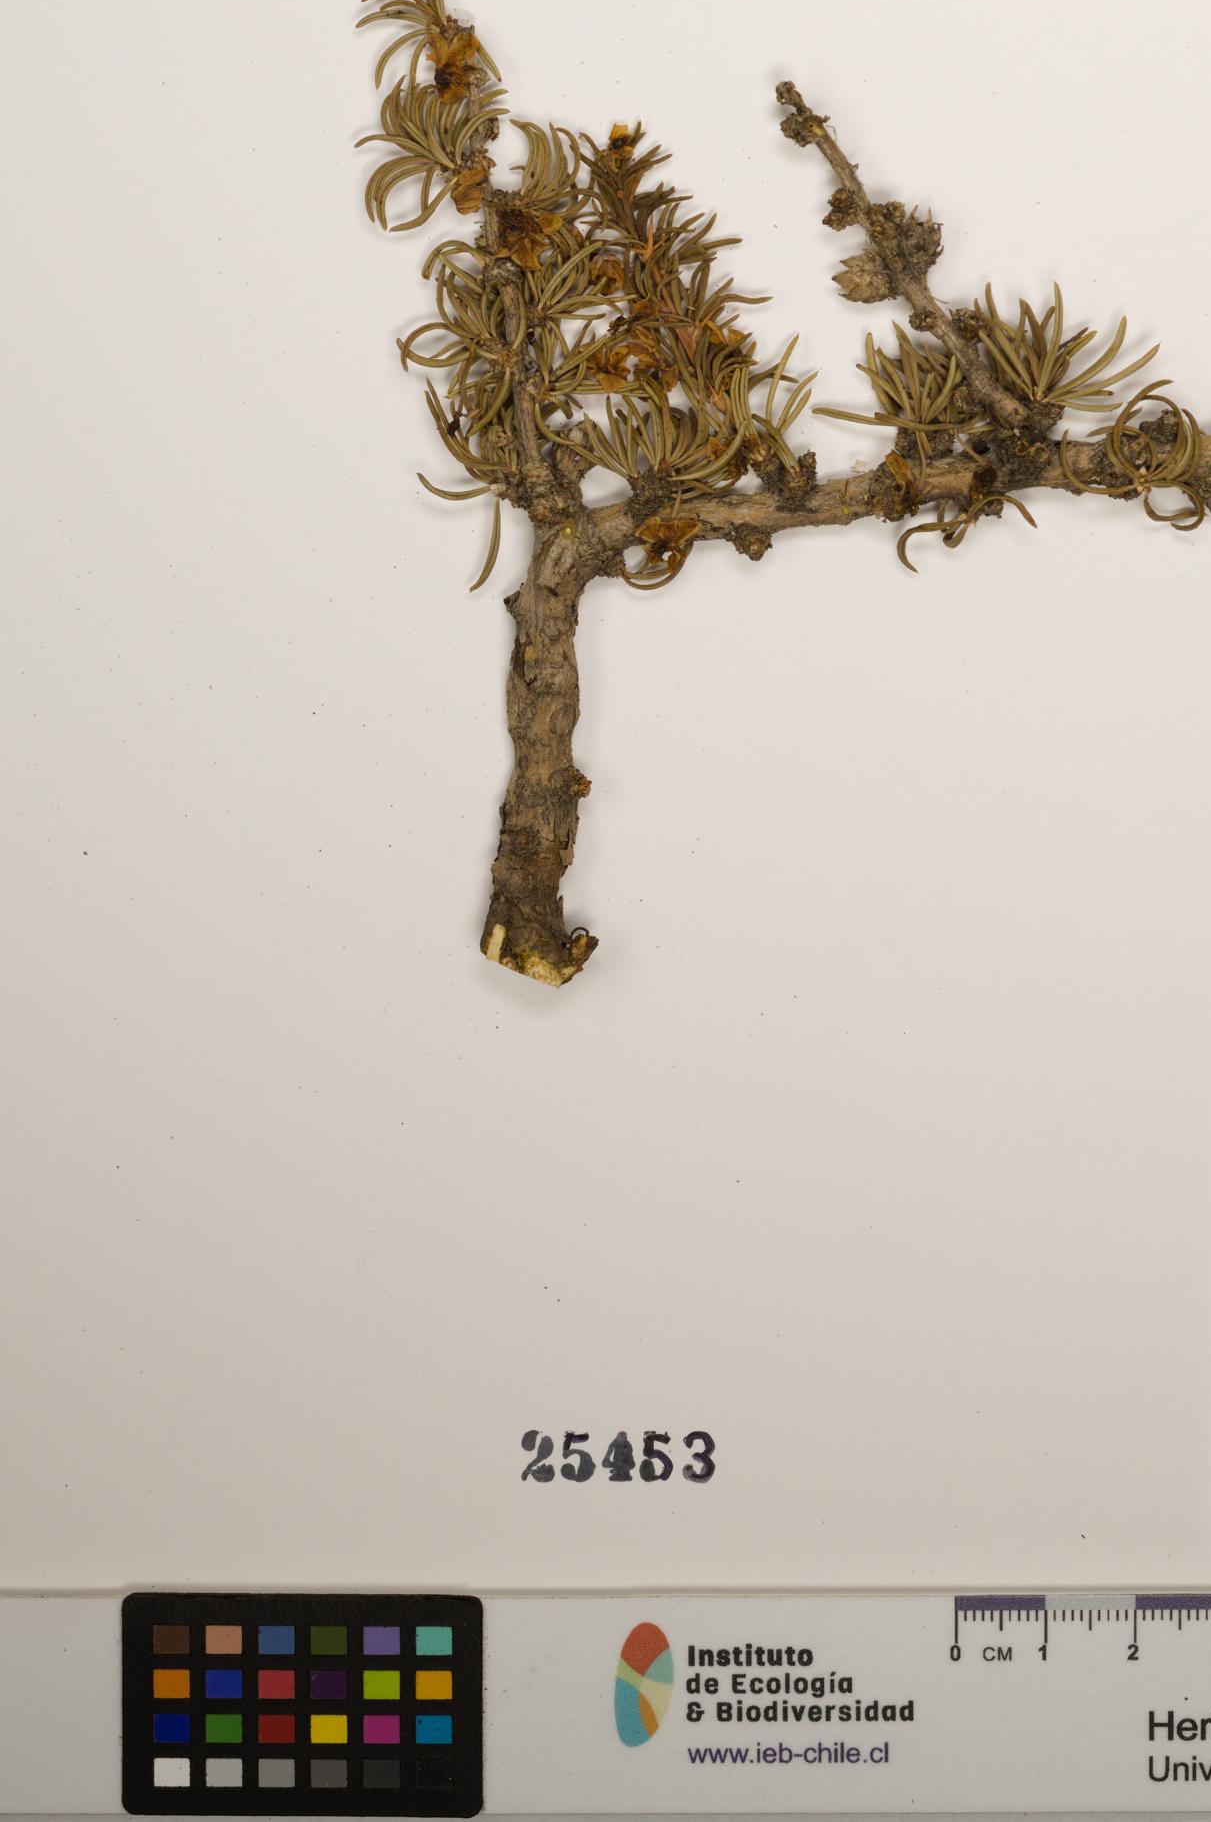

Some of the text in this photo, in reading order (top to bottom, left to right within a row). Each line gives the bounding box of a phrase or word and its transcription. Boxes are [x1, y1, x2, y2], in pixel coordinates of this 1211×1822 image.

[521, 1430, 715, 1483] 25453
[688, 1643, 813, 1667] Instituto
[950, 1644, 961, 1661] 0
[983, 1647, 1012, 1661] CM
[1038, 1644, 1048, 1661] 1
[1127, 1643, 1139, 1661] 2
[686, 1672, 852, 1699] de Ecología
[686, 1700, 914, 1723] & Biodiversidad
[688, 1741, 889, 1765] www.ieb-chile.cl
